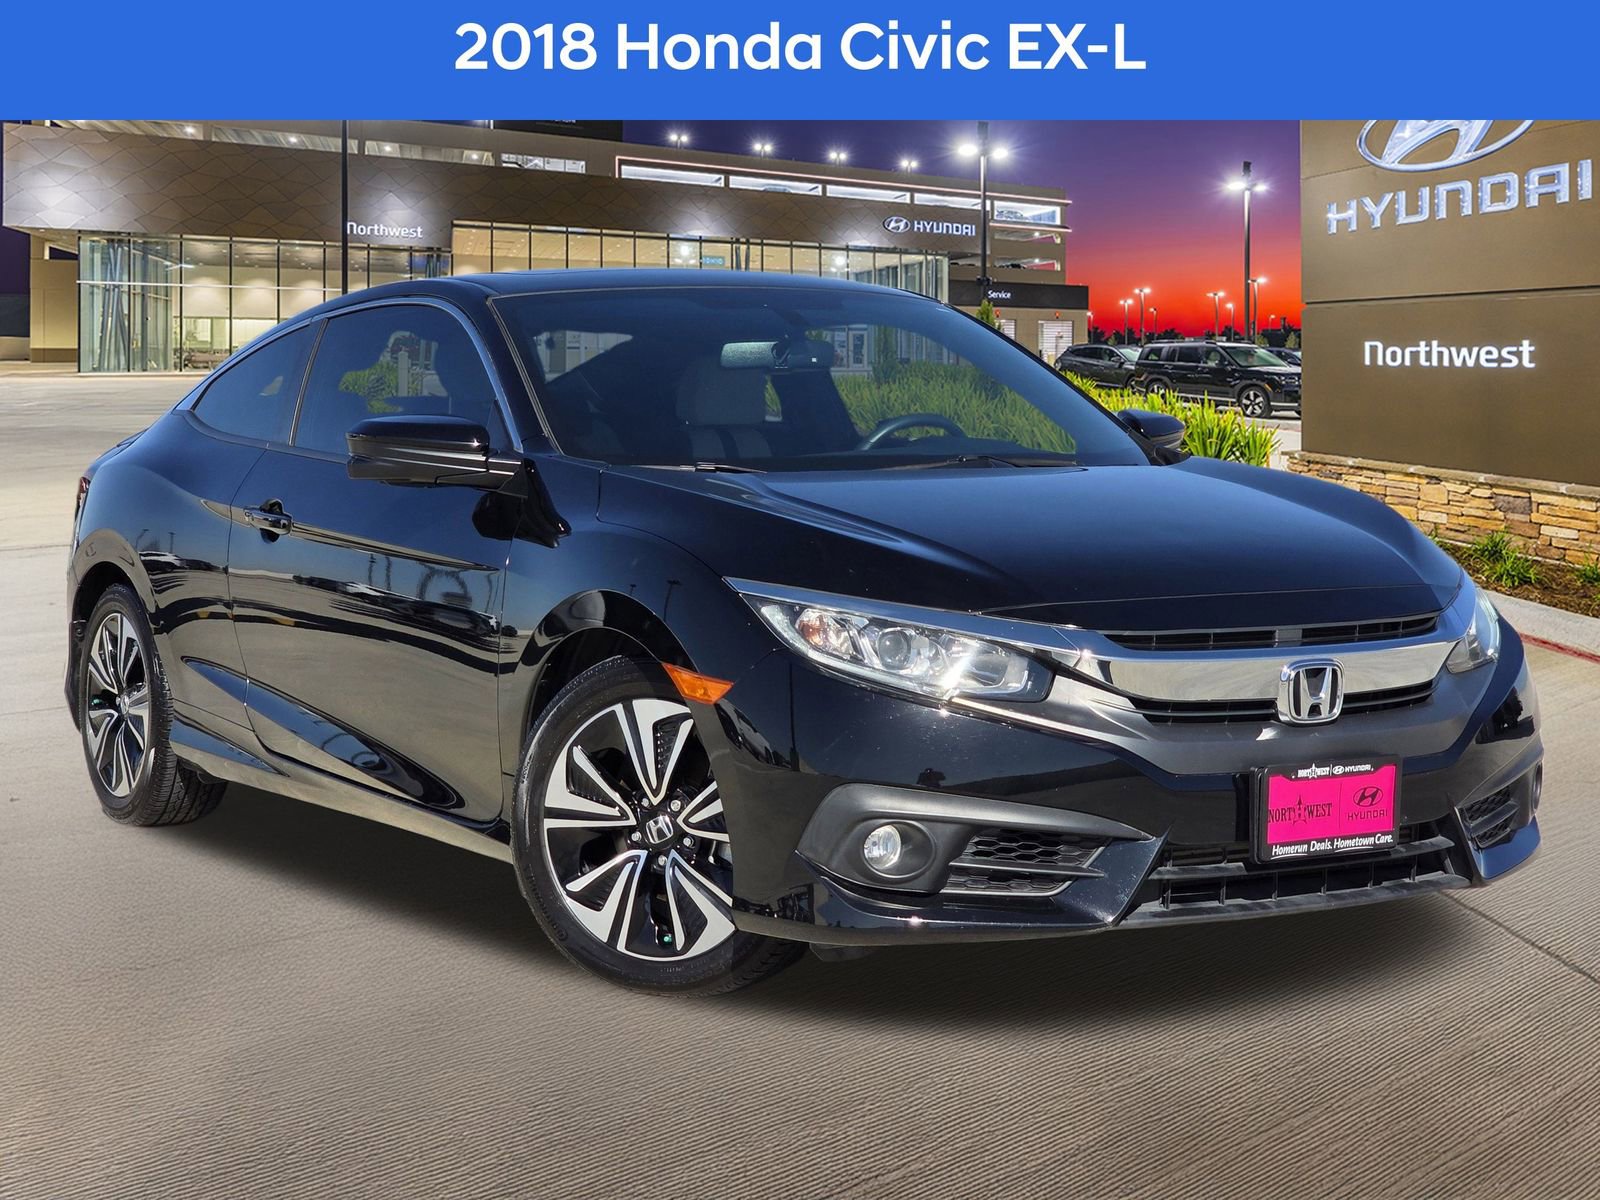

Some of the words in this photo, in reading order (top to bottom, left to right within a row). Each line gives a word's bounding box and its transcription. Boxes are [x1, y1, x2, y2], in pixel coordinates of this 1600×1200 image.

[1326, 159, 1593, 235] HYUNDAI
[346, 221, 424, 238] Northwest
[913, 220, 977, 237] HYUNDAI
[987, 290, 1012, 299] Service
[1363, 339, 1536, 369] Northwest
[1347, 808, 1388, 821] HYUNDAI
[1271, 844, 1308, 856] Homerun
[1310, 838, 1333, 852] Deals.
[1333, 835, 1374, 849] Hometown
